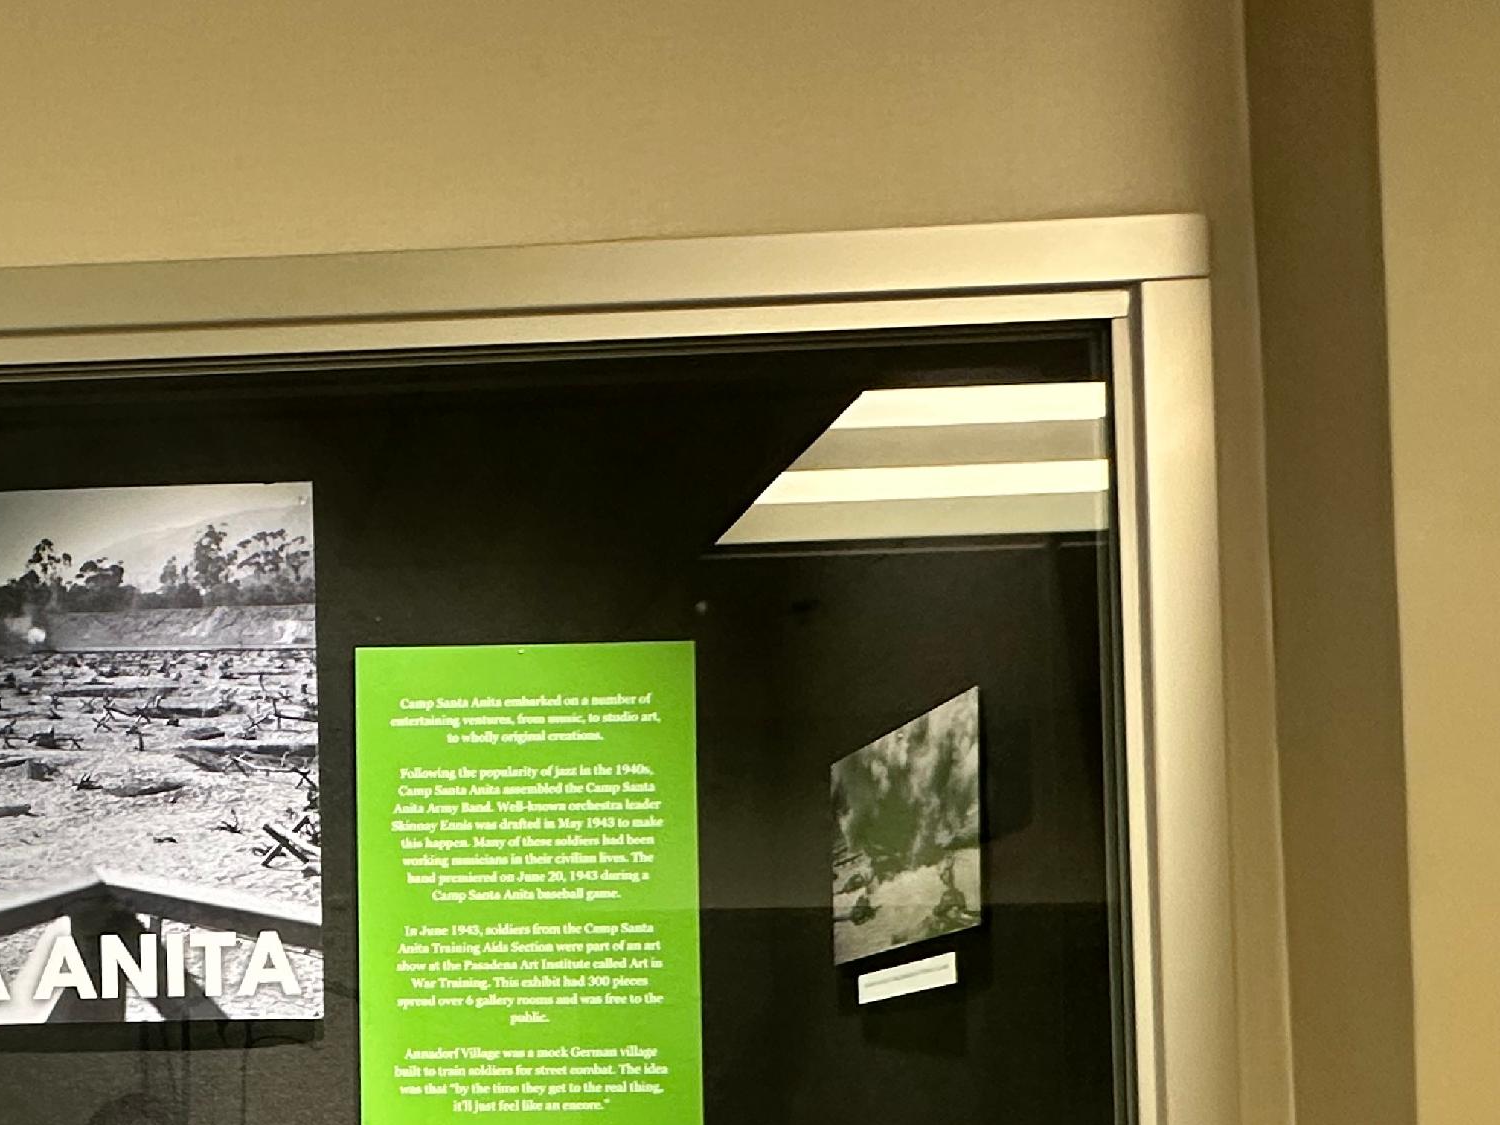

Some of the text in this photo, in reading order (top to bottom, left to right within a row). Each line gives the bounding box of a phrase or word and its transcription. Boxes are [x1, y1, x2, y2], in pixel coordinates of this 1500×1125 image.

[399, 698, 434, 712] Camp
[435, 697, 469, 709] Santa
[470, 696, 502, 708] Anita
[503, 695, 562, 707] embarked
[562, 697, 580, 706] on
[590, 694, 636, 706] number
[637, 693, 652, 705] of
[389, 715, 461, 729] entertaining
[516, 713, 545, 725] from
[587, 712, 600, 723] to
[601, 711, 639, 723] studio
[446, 732, 460, 744] to
[460, 732, 499, 746] wholly
[500, 731, 546, 745] original
[400, 767, 457, 781] Following
[457, 767, 477, 778] the
[478, 765, 538, 780] popularity
[539, 765, 553, 777] of
[553, 766, 577, 779] jazz
[579, 764, 592, 776] in
[593, 764, 612, 776] the
[407, 872, 437, 884] band
[436, 871, 498, 886] premiered
[498, 873, 515, 883] on
[515, 871, 546, 882] June
[570, 870, 599, 881] 1943
[599, 869, 640, 883] during
[404, 925, 417, 937] In
[419, 925, 448, 937] June
[484, 923, 531, 936] soldiers
[531, 923, 561, 935] from
[562, 923, 582, 934] the
[583, 922, 618, 936] Camp
[620, 921, 654, 933] Santa
[33, 930, 301, 1001] ANITA
[411, 978, 436, 989] War
[492, 976, 519, 988] This
[520, 976, 560, 987] exhibit
[562, 975, 586, 987] had
[587, 975, 611, 986] 300
[610, 974, 648, 988] pieces
[453, 1100, 473, 1112] it'll
[473, 1100, 496, 1114] just
[497, 1100, 520, 1111] feel
[520, 1099, 543, 1111] like
[544, 1101, 560, 1111] an
